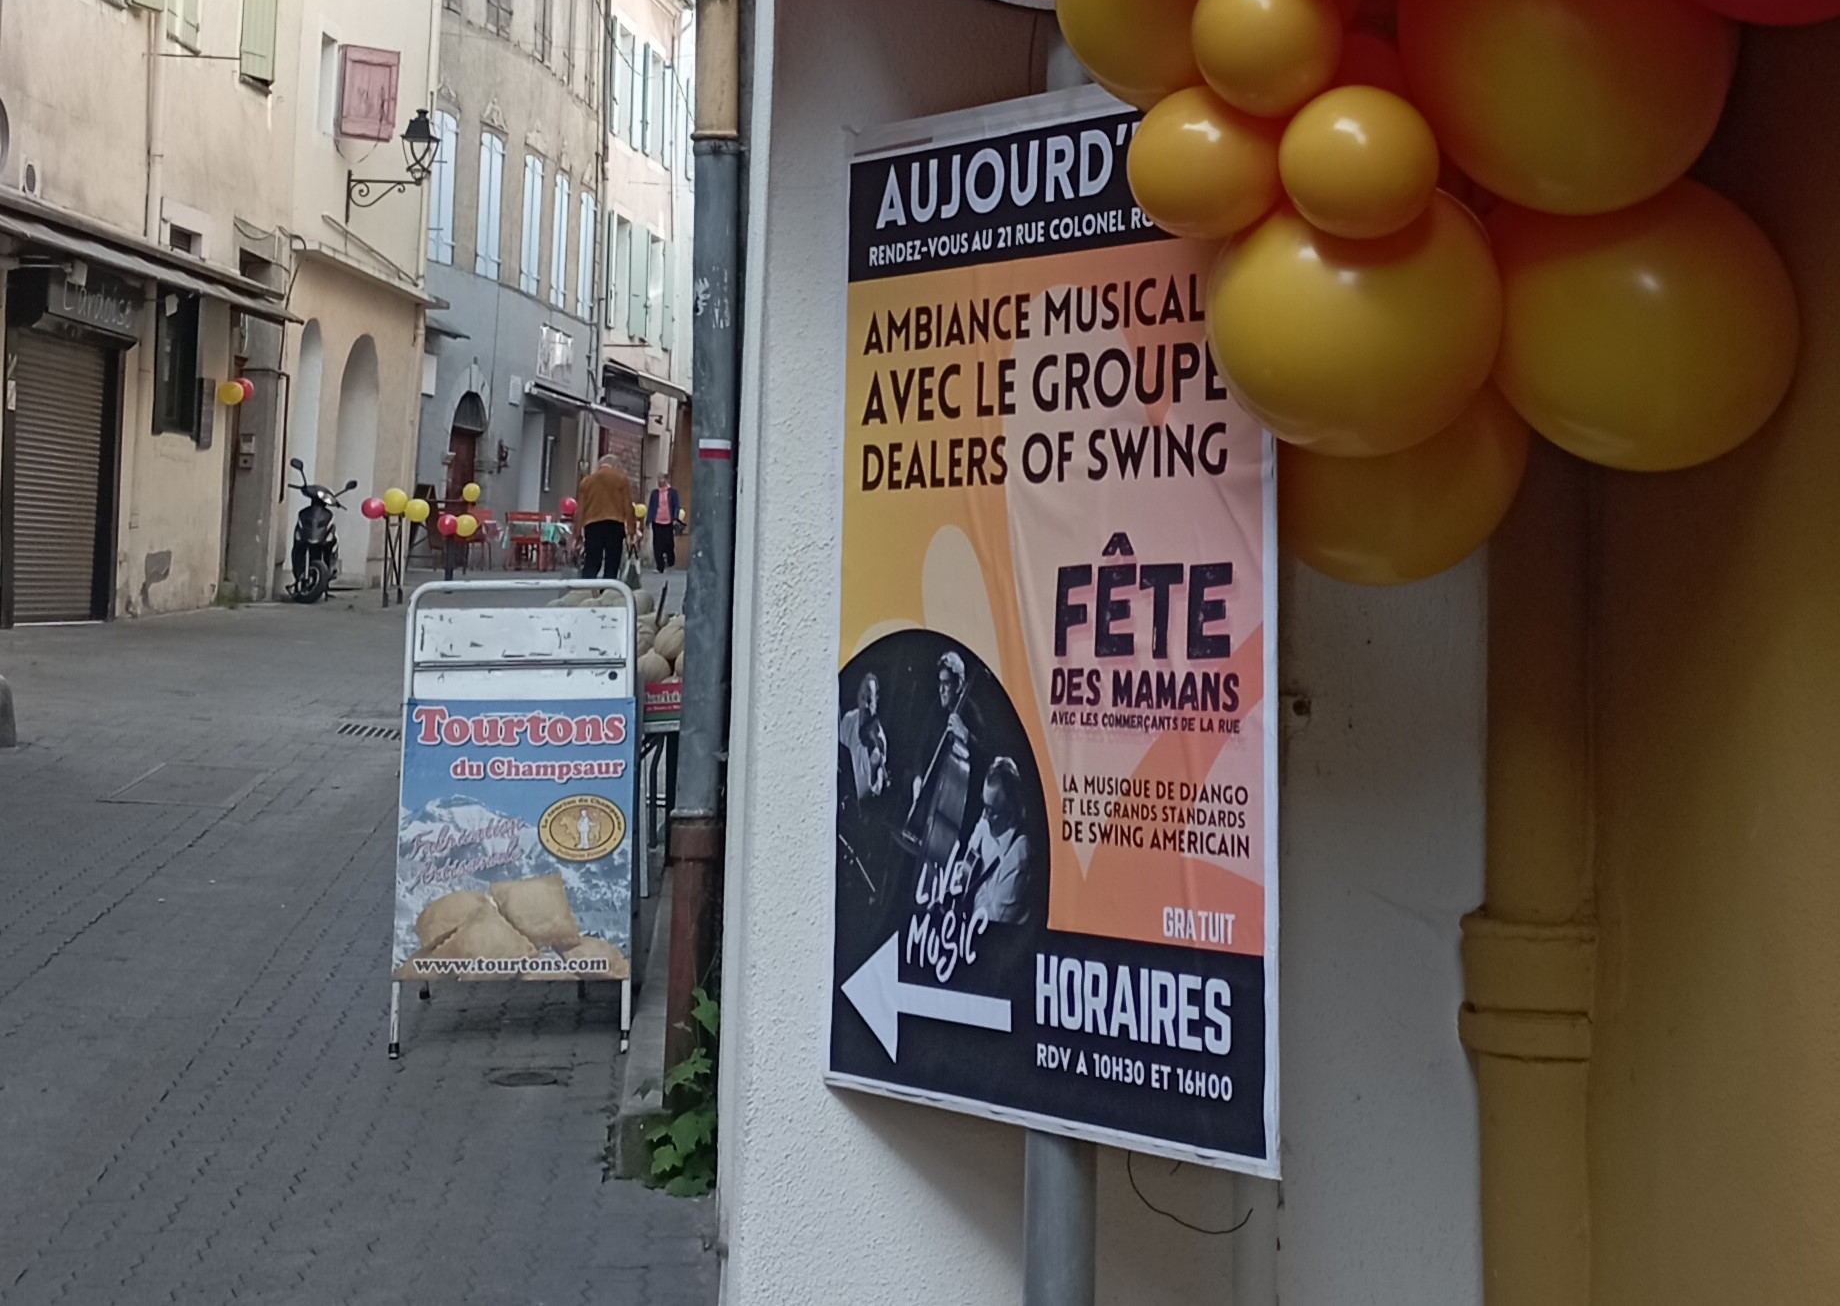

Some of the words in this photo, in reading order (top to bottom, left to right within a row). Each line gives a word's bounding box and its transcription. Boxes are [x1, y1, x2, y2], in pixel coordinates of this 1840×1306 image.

[876, 121, 1141, 230] AUJOURD'
[869, 232, 968, 266] RENDEZ-VOUS
[971, 229, 992, 252] AU
[997, 226, 1012, 248] 21
[1016, 221, 1045, 246] RUE
[1050, 209, 1126, 240] COLONEL
[863, 292, 1031, 356] AMBIANCE
[1044, 273, 1205, 337] MUSICAL
[861, 363, 961, 426] AVEC
[976, 359, 1016, 417] LE
[1032, 341, 1228, 412] GROUPE
[862, 435, 1008, 491] DEALERS
[1022, 431, 1074, 484] OF
[1087, 422, 1228, 481] SWING
[1054, 531, 1233, 660] FÊTE
[1050, 667, 1101, 706] DES
[1111, 669, 1240, 713] MAMANS
[413, 706, 625, 745] Tourtons
[1050, 710, 1076, 726] AVEC
[1080, 712, 1099, 727] LES
[1102, 712, 1179, 733] COMMERÇANTS
[1181, 717, 1196, 732] DE
[1200, 718, 1214, 733] LA
[1218, 719, 1240, 734] RUE
[451, 758, 484, 779] du
[487, 757, 625, 782] Champsaur
[1063, 774, 1078, 794] LA
[1084, 775, 1150, 799] MUSIQUE
[1156, 781, 1175, 801] DE
[1180, 782, 1249, 806] DJANGO
[1062, 798, 1075, 814] ET
[1080, 799, 1100, 817] LES
[1104, 801, 1158, 821] GRANDS
[1161, 805, 1246, 829] STANDARDS
[1062, 820, 1083, 843] DE
[1088, 821, 1144, 848] SWING
[1149, 827, 1251, 860] AMERICAIN
[1162, 906, 1236, 946] GRATUIT
[413, 956, 609, 974] www.tourtons.com
[1035, 953, 1233, 1056] HORAIRES
[1036, 1043, 1072, 1072] RDV
[1075, 1050, 1088, 1076] A
[1093, 1053, 1145, 1085] 10H30
[1151, 1063, 1171, 1091] ET
[1176, 1068, 1233, 1102] 16H00
